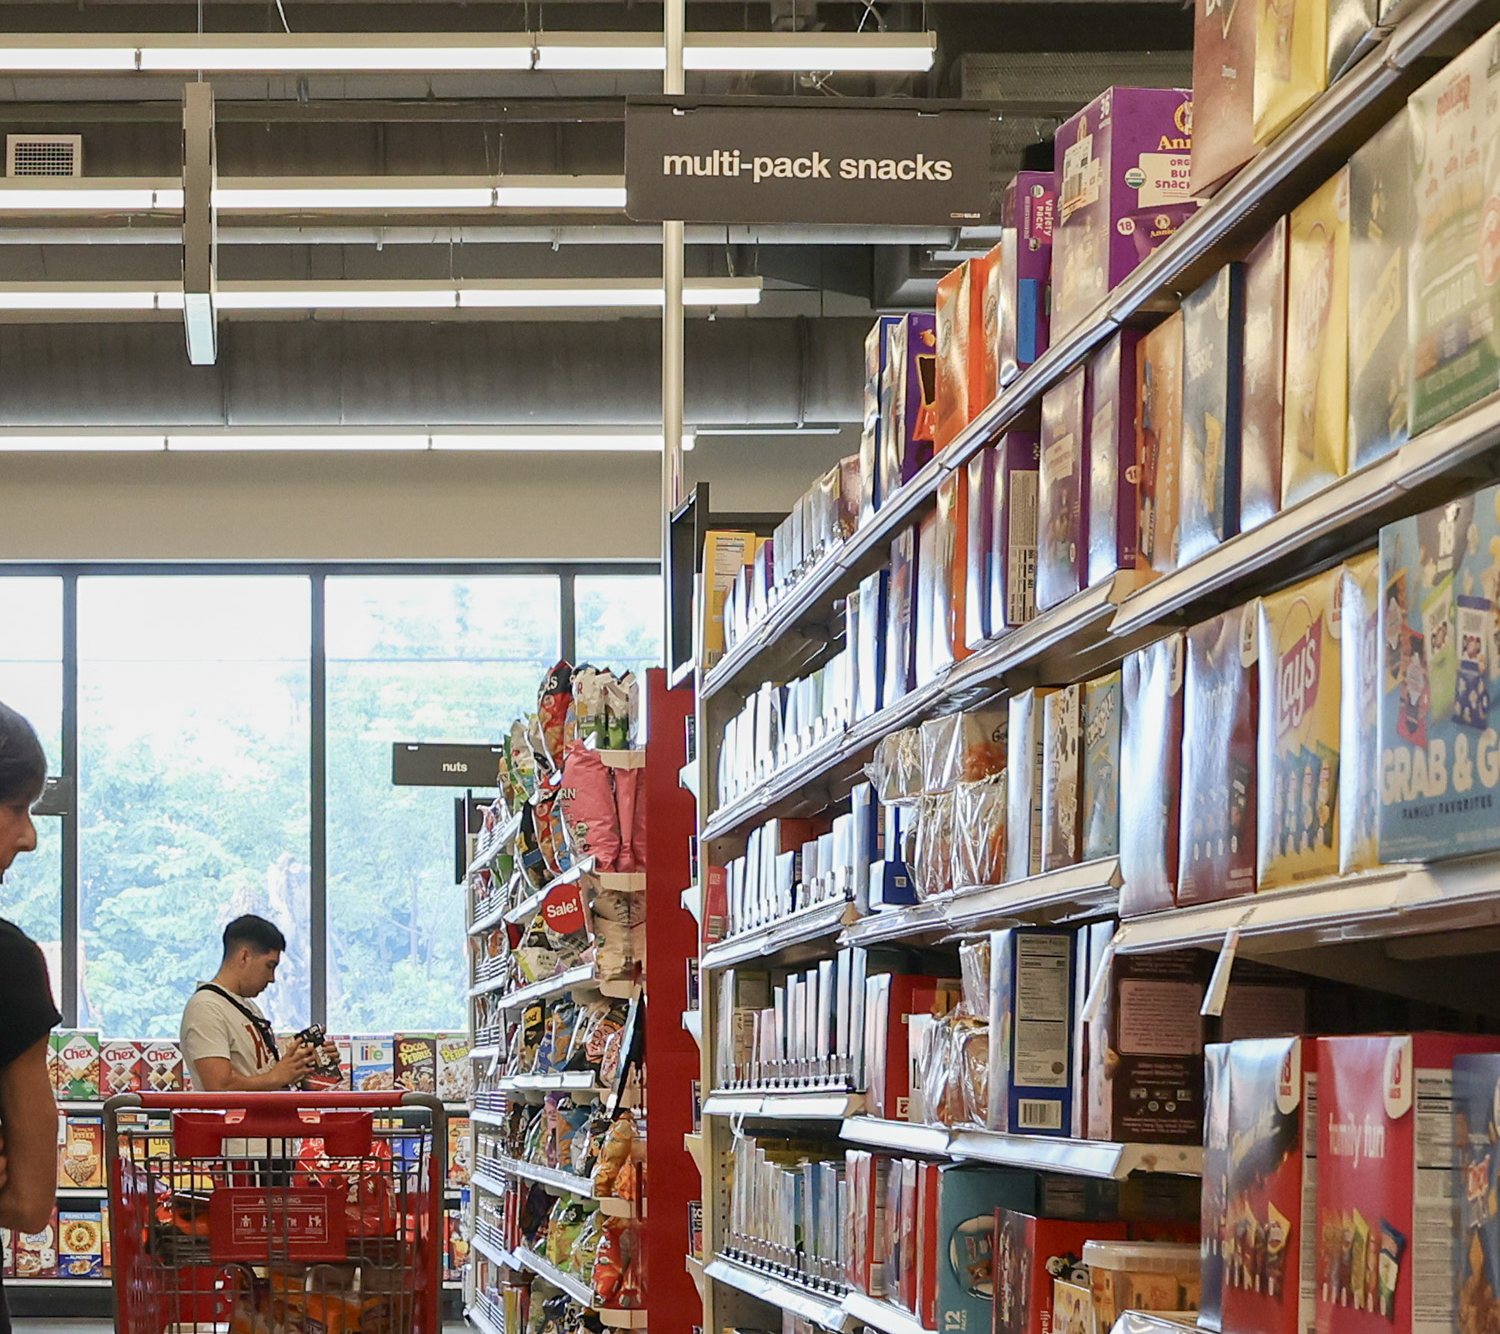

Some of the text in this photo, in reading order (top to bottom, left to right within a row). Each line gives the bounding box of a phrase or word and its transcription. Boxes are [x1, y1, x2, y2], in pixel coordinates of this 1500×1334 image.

[663, 150, 953, 183] multi-pack snacks
[1119, 221, 1133, 231] 18
[1382, 733, 1471, 805] GRAB &
[546, 897, 579, 920] Sale!
[62, 1045, 93, 1062] Chex
[105, 1047, 135, 1063] Chex
[146, 1047, 177, 1063] Chex
[360, 1042, 383, 1062] life
[400, 1041, 430, 1055] COCOA
[398, 1049, 434, 1067] PEBBLES
